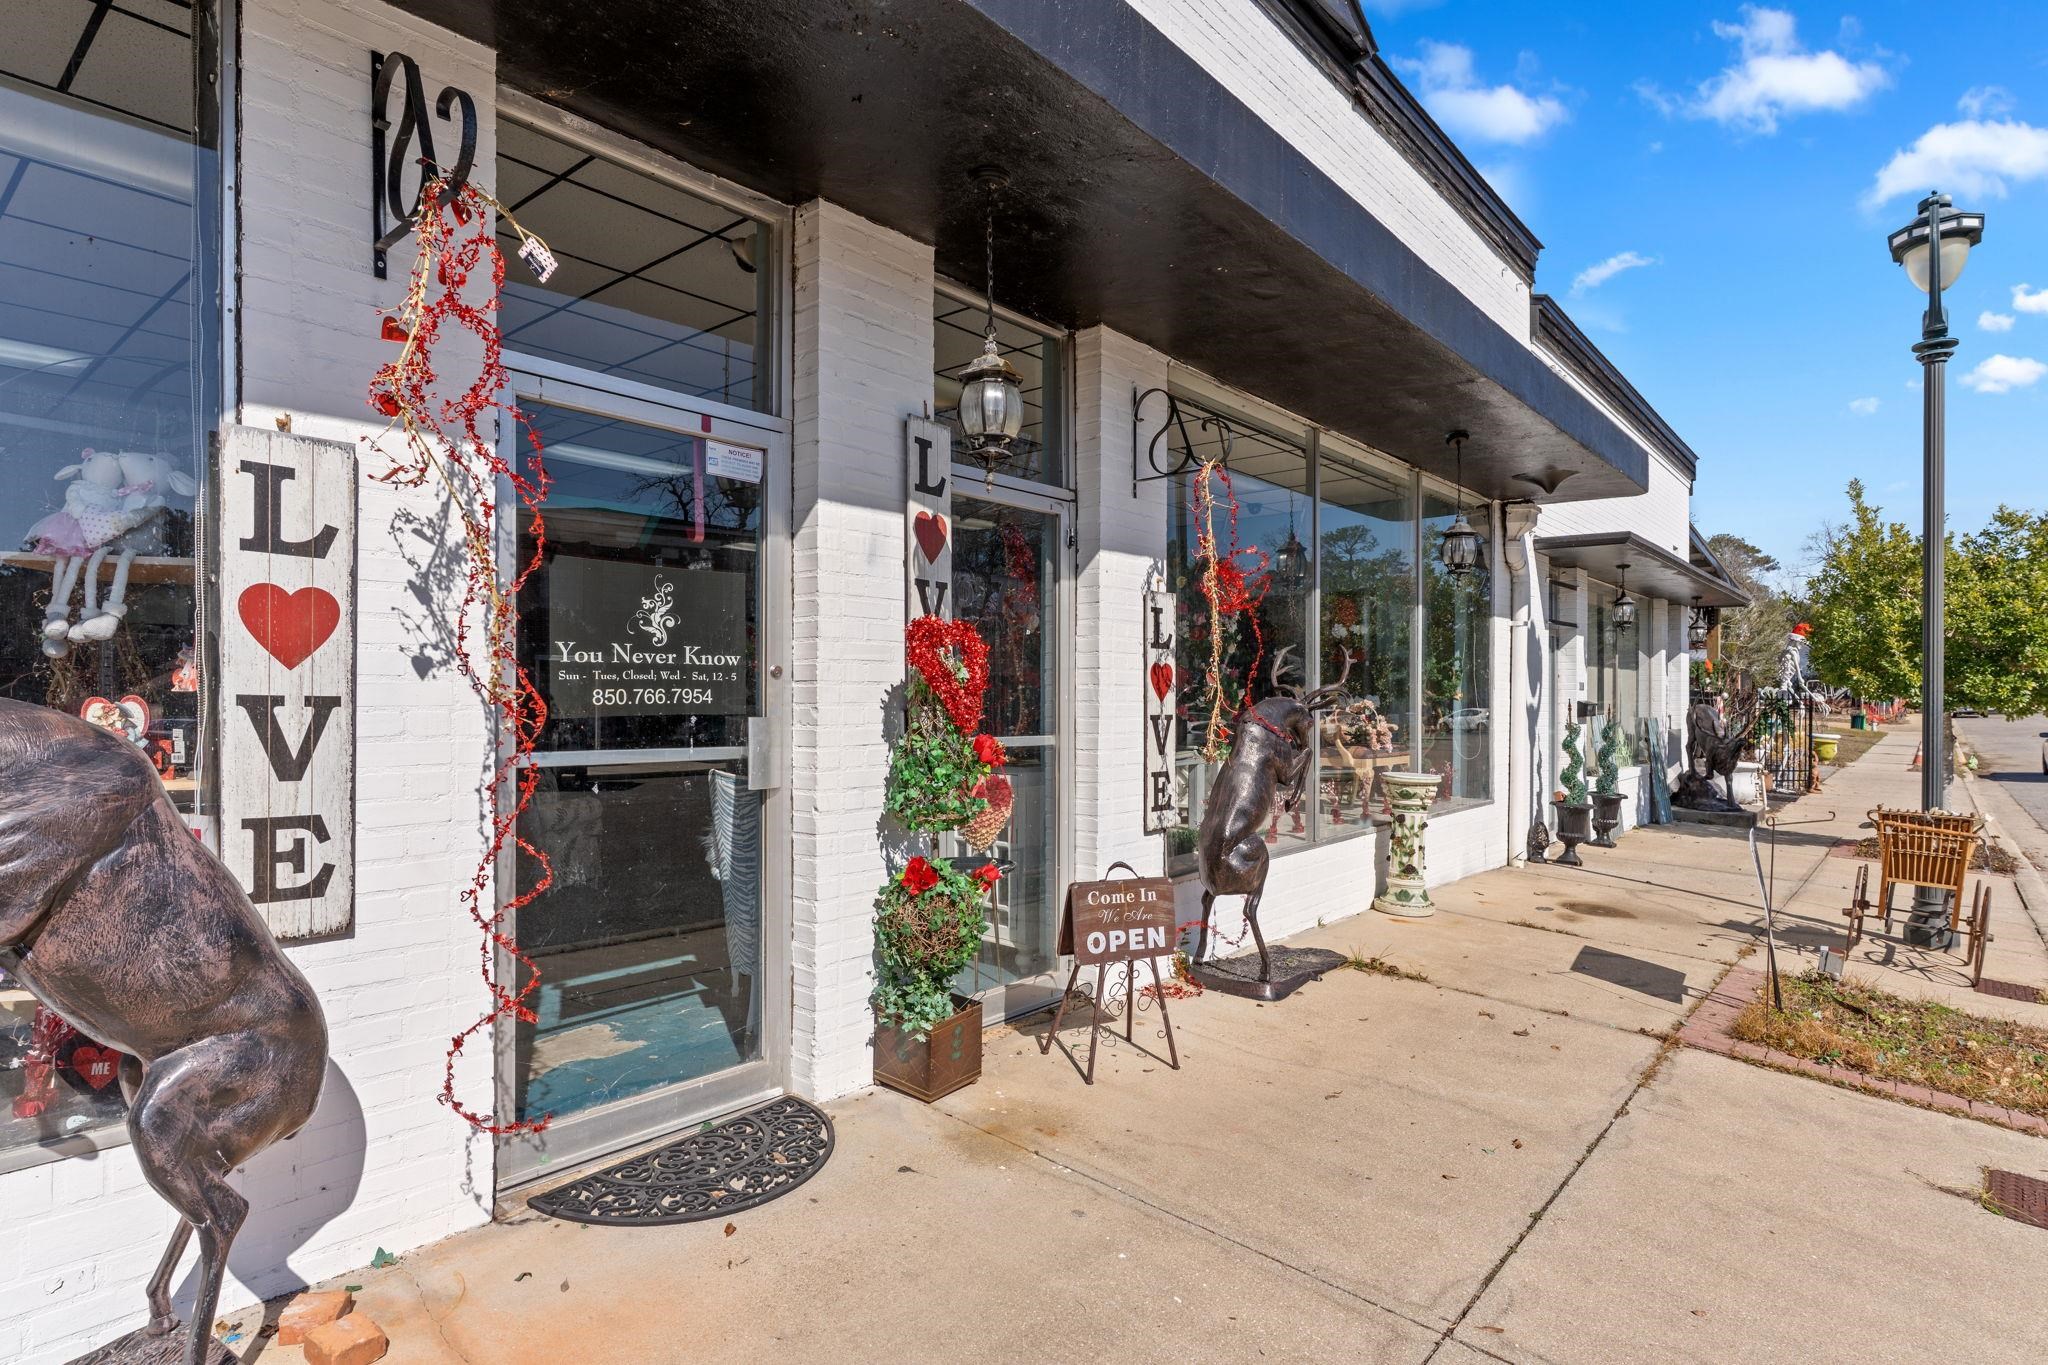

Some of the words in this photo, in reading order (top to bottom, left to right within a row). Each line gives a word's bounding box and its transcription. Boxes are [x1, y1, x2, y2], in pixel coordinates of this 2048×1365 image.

[728, 449, 752, 459] NOTICE!
[554, 641, 604, 663] You
[611, 643, 677, 665] Never
[683, 645, 741, 666] Know
[558, 670, 580, 681] Sun
[593, 670, 620, 682] Tues,
[622, 669, 657, 681] Closed;
[659, 670, 681, 681] Wed
[691, 672, 709, 682] Sat,
[712, 672, 723, 681] 12
[731, 672, 737, 681] 5
[592, 688, 713, 706] 850.766.7954
[1087, 890, 1135, 906] Come
[1139, 887, 1158, 902] In
[1097, 908, 1120, 924] We
[1123, 906, 1154, 922] Are
[1086, 926, 1166, 955] OPEN
[91, 1061, 111, 1076] ME
